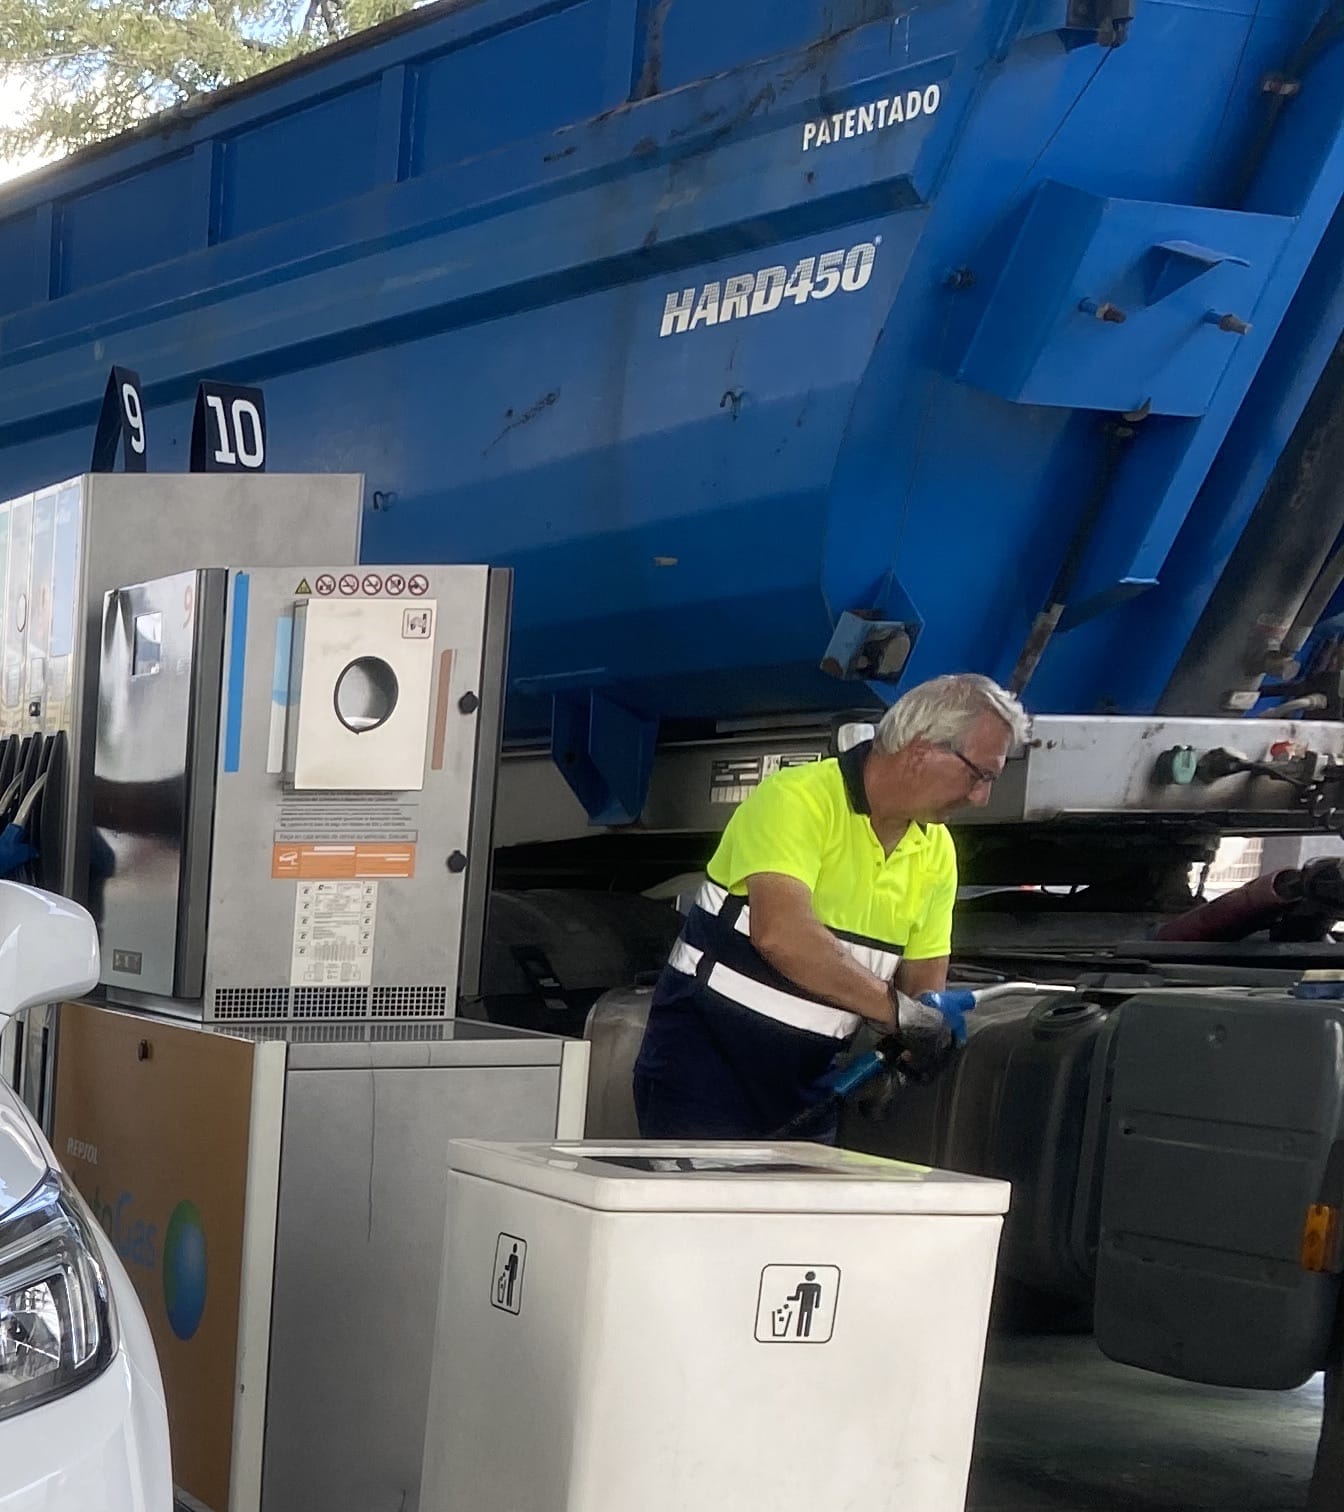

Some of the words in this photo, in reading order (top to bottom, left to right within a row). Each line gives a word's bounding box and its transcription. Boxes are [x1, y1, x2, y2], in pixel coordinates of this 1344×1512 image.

[802, 84, 941, 151] PATENTADO
[659, 242, 875, 337] HARD450
[122, 383, 145, 454] 9
[206, 395, 264, 468] 10
[183, 585, 193, 629] 9
[66, 1136, 98, 1165] REPSOL
